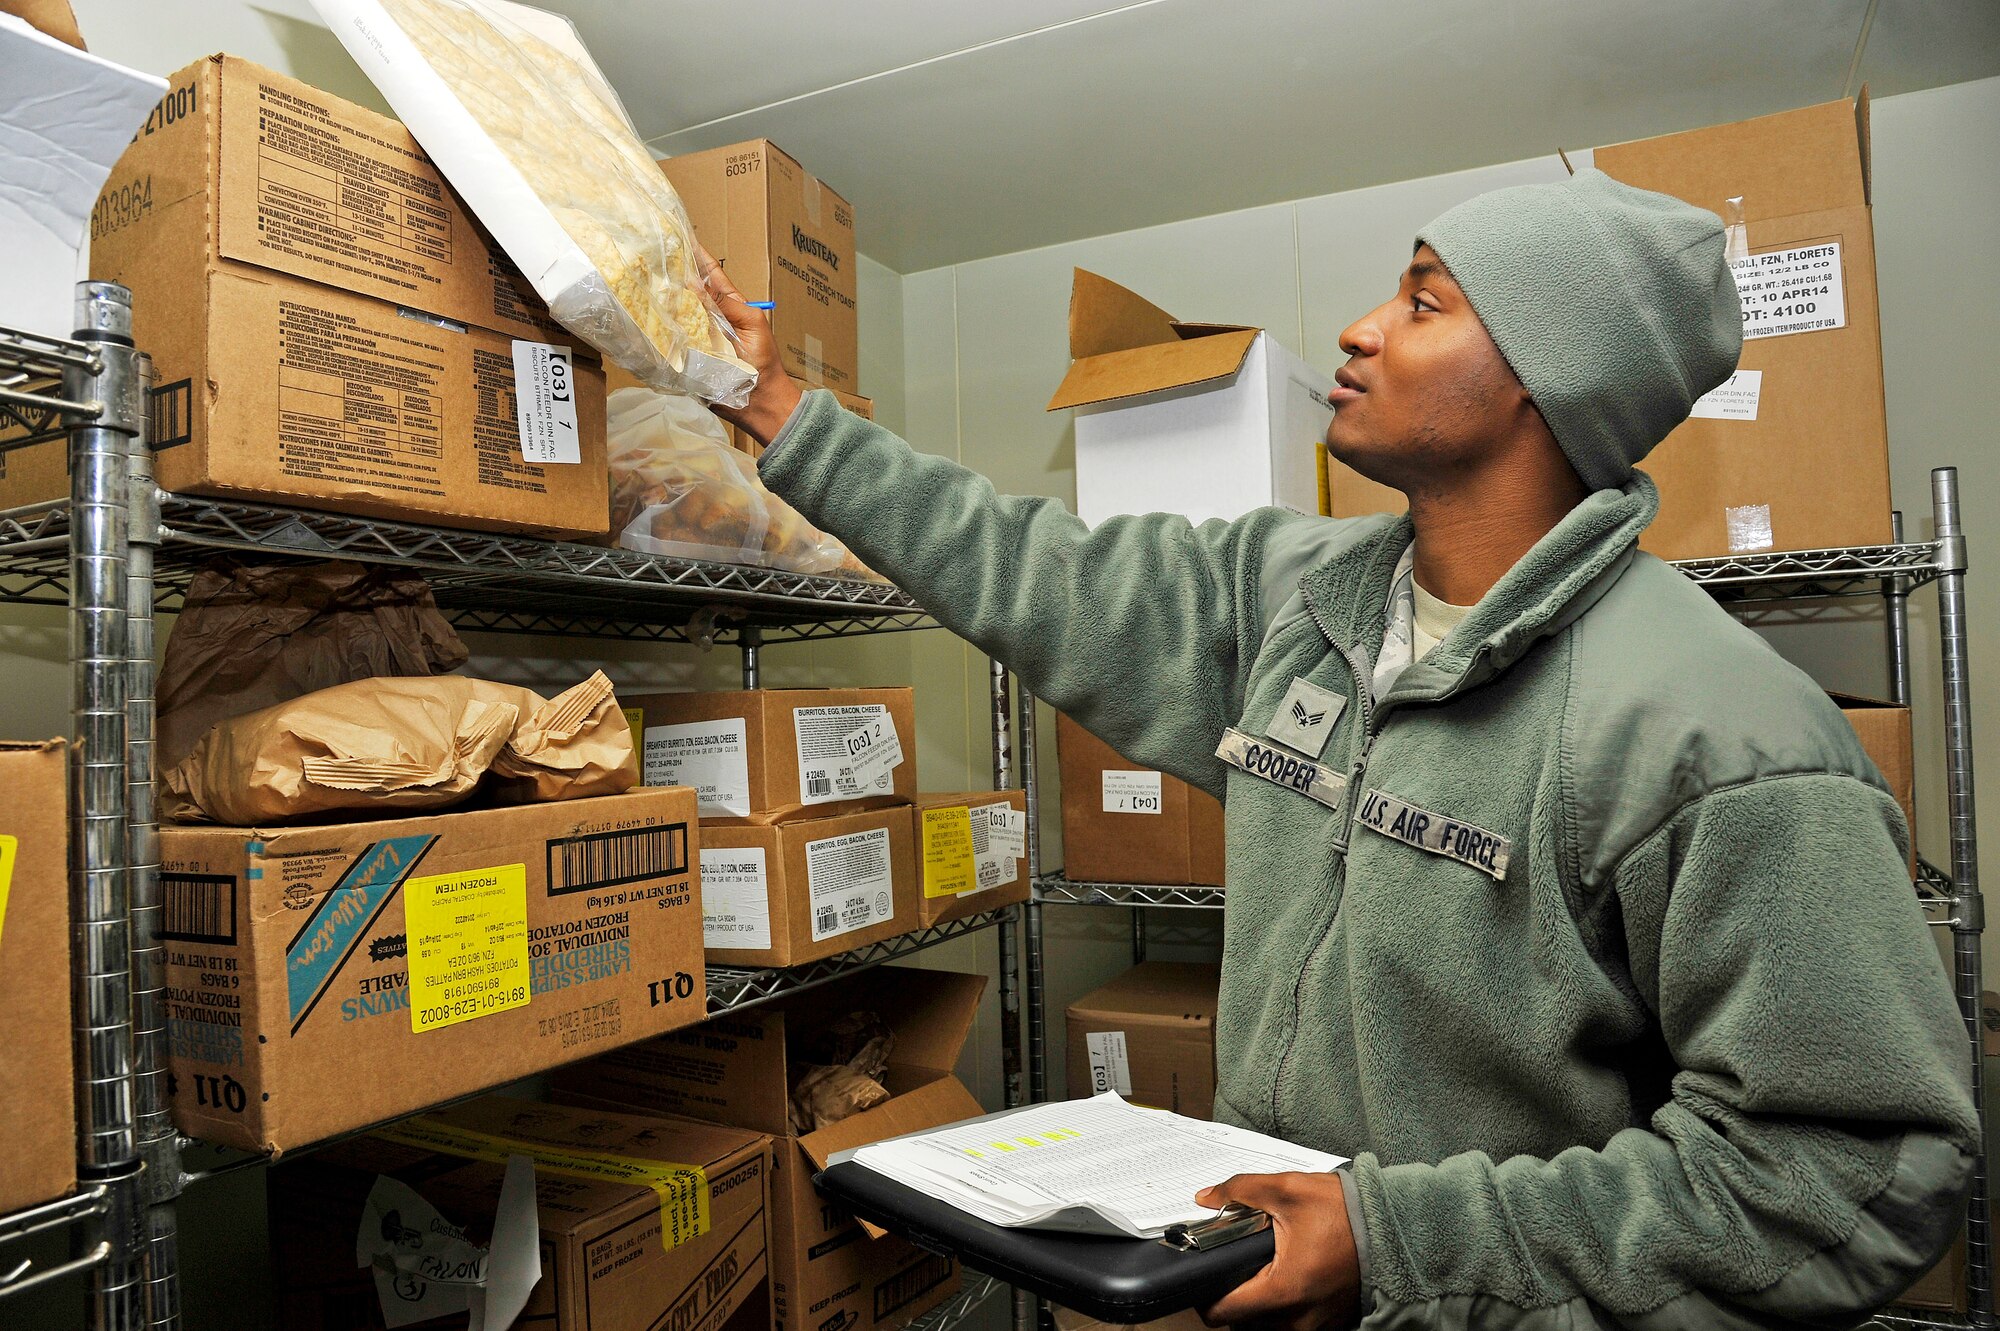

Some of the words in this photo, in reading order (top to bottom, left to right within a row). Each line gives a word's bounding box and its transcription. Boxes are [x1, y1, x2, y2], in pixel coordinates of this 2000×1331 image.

[259, 84, 292, 103] HANDLING
[293, 97, 330, 117] DIRECTIONS:
[259, 106, 302, 129] PREPARATION
[304, 123, 340, 143] DIRECTIONS:
[726, 160, 760, 177] 60317
[268, 185, 298, 200] CONVECTION
[300, 194, 312, 204] OVEN
[344, 177, 365, 191] THAWED
[367, 184, 389, 198] BISCUITS
[265, 196, 300, 213] CONVENTIONAL
[302, 207, 314, 217] OVEN
[406, 199, 425, 212] FROZEN
[427, 206, 446, 219] BISCUITS
[258, 205, 291, 223] WARMING
[292, 215, 317, 230] CABINET
[835, 211, 852, 230] 60317
[792, 222, 839, 272] KRUSTEAZ
[1761, 254, 1784, 267] FZN,
[1787, 247, 1835, 261] FLORETS
[1736, 270, 1764, 280] SIZE:
[1769, 266, 1792, 275] 12/2
[778, 256, 810, 284] GRIDDLED
[812, 274, 836, 298] FRENCH
[837, 292, 855, 310] TOAST
[1752, 283, 1763, 292] GR.
[1806, 273, 1832, 284] CU:1.68
[807, 286, 829, 306] STICKS
[1761, 293, 1777, 303] 10
[1782, 286, 1829, 301] APR14
[280, 301, 319, 316] INSTRUCCIONES
[321, 311, 334, 319] PARA
[336, 314, 356, 324] MANEJO
[1773, 302, 1816, 318] 4100
[280, 321, 319, 335] INSTRUCCIONES
[320, 329, 334, 338] PARA
[335, 332, 341, 340] LA
[1815, 320, 1823, 328] OF
[1824, 318, 1836, 327] USA
[540, 348, 549, 386] FALCON
[347, 382, 372, 392] BIZCOCHOS
[1730, 375, 1737, 385] 1
[347, 390, 383, 401] DESCONGELADOS
[544, 389, 553, 419] FEEDR
[798, 708, 827, 716] BURRITOS,
[875, 724, 880, 737] 2
[720, 734, 737, 744] CHEESE
[811, 770, 825, 779] 22450
[1245, 744, 1316, 792] COOPER
[1011, 816, 1015, 825] 1
[1361, 793, 1388, 828] U.S.
[1391, 807, 1431, 845] AIR
[1440, 824, 1501, 871] FORCE
[811, 840, 836, 852] BURRITOS,
[838, 838, 848, 847] EGG,
[849, 835, 866, 845] BACON,
[867, 831, 884, 841] CHEESE
[435, 882, 458, 894] ITEM
[460, 877, 497, 891] FROZEN
[646, 886, 664, 898] NET
[665, 884, 677, 895] LB
[679, 882, 689, 892] 18
[587, 896, 601, 910] kg)
[604, 891, 627, 907] (8.16
[629, 888, 644, 902] WT
[658, 895, 683, 910] BAGS
[684, 894, 690, 904] 6
[821, 905, 833, 915] 22450
[586, 911, 629, 929] FROZEN
[554, 925, 630, 952] INDIVIDUAL
[171, 952, 188, 967] WT
[190, 955, 208, 969] NET
[209, 956, 222, 970] LB
[224, 958, 239, 971] 18
[447, 957, 457, 968] EA
[458, 955, 467, 965] OZ
[201, 972, 229, 986] BAGS
[453, 969, 466, 981] BRN
[467, 966, 484, 978] HASH
[574, 957, 631, 986] LAMB'S
[230, 974, 239, 989] 6
[444, 977, 500, 1000] 8915901918
[647, 971, 694, 1008] Q11
[196, 993, 240, 1008] FROZEN
[420, 986, 525, 1024] 8915-01-E29-8002
[173, 1008, 242, 1027] INDIVIDUAL
[193, 1073, 246, 1113] Q11
[670, 1203, 679, 1248] roduct,
[592, 1264, 612, 1280] KEEP
[614, 1248, 643, 1269] FROZEN
[809, 1298, 830, 1314] KEEP
